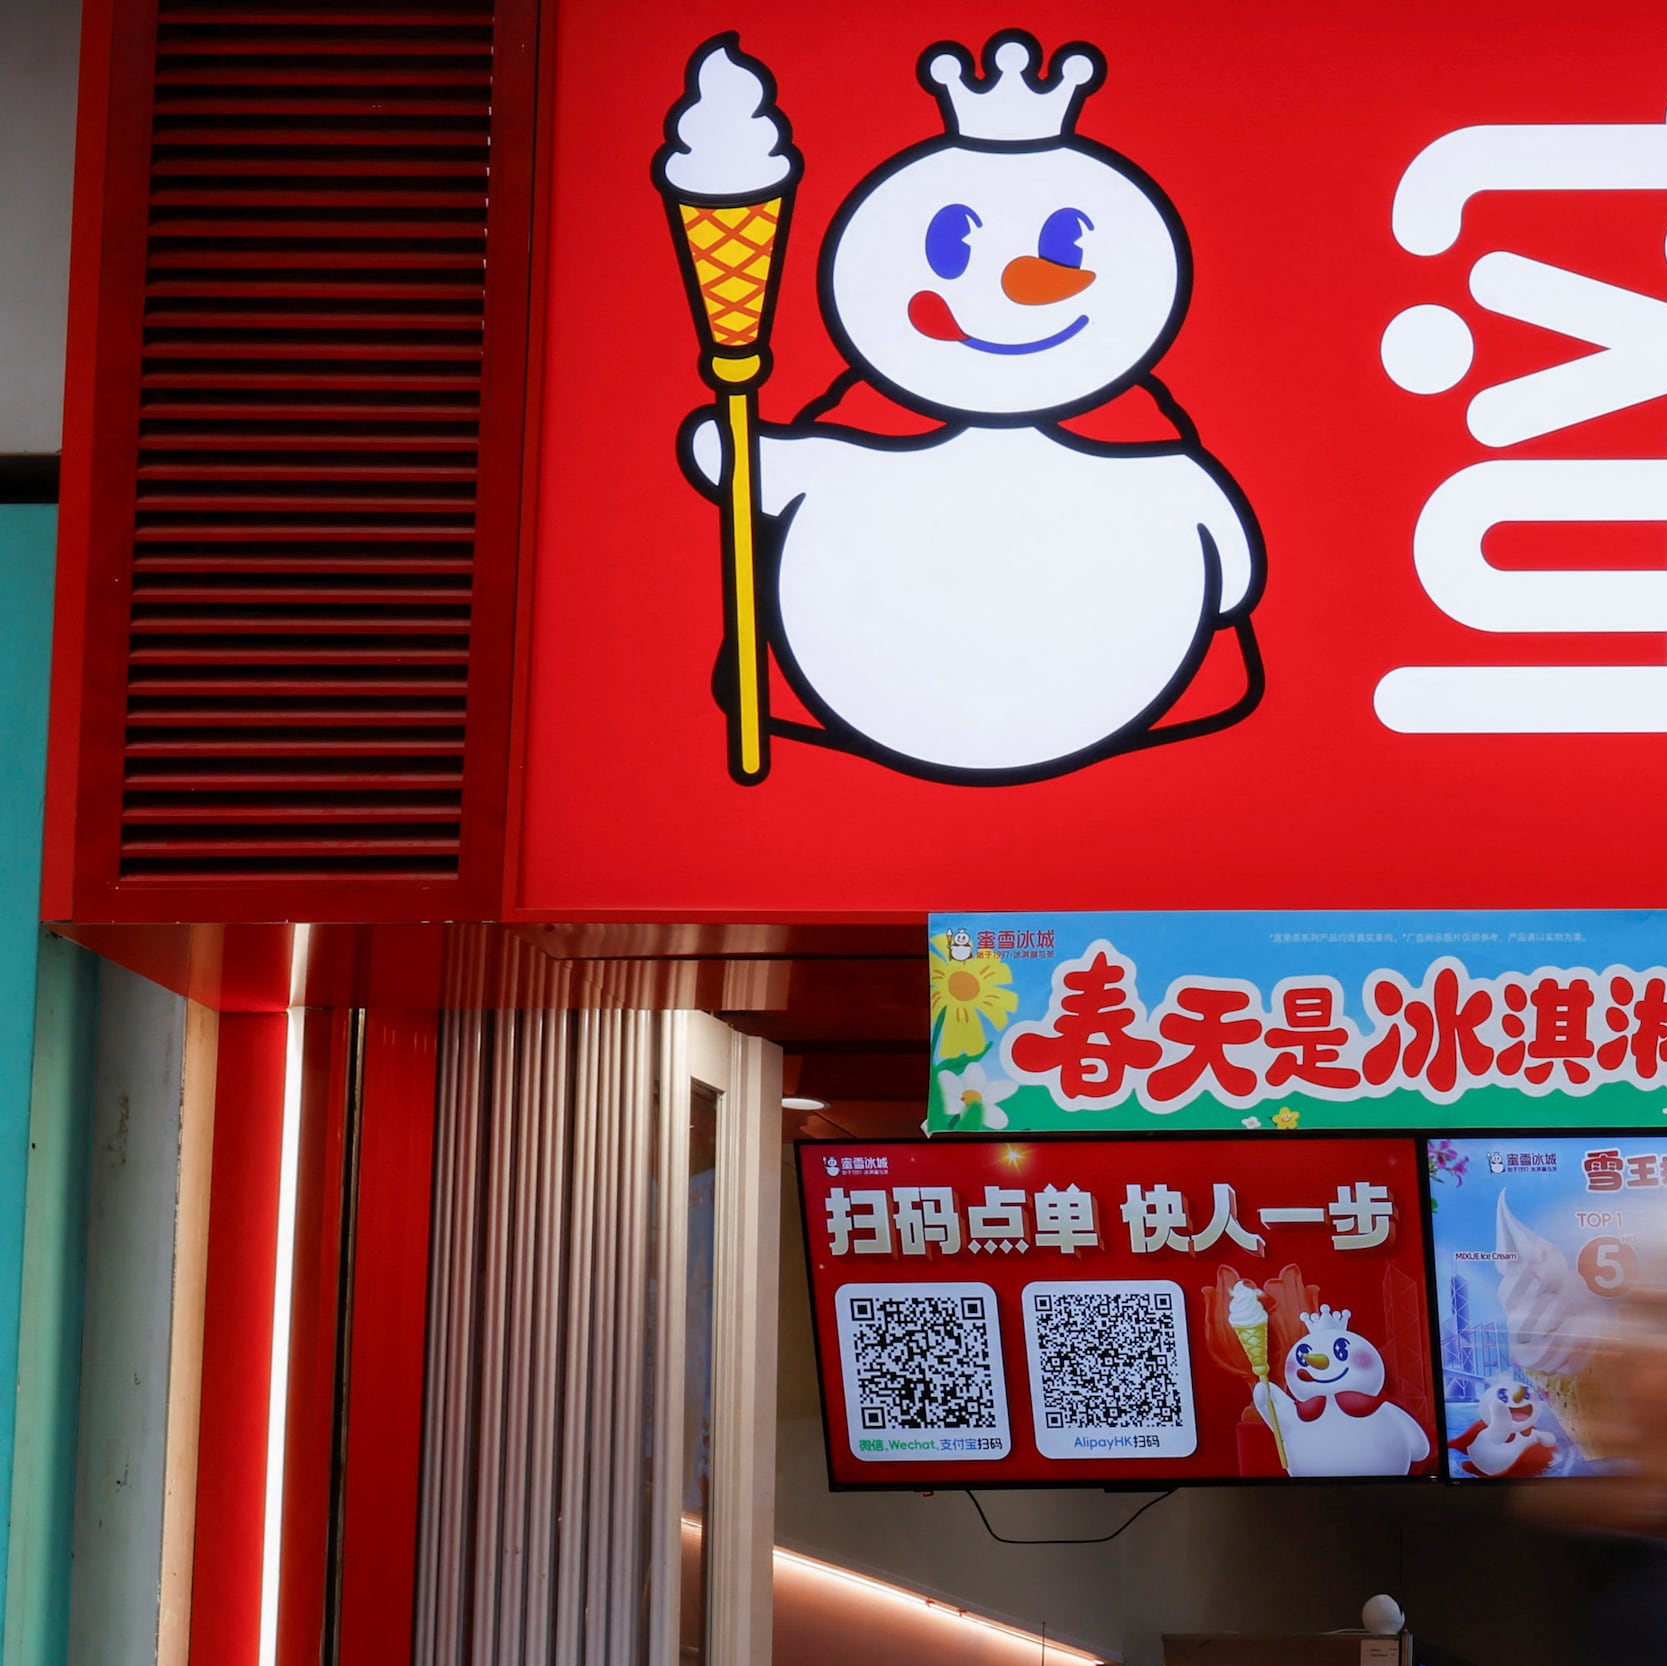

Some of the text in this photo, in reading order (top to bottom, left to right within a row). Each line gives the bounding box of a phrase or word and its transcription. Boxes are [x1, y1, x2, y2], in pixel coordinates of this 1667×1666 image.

[977, 930, 1055, 949] 蜜雪冰城
[1506, 1153, 1557, 1165] 蜜雪冰城
[825, 1181, 1394, 1256] 扫码点单 快人一步
[1576, 1213, 1623, 1228] TOP 1
[1594, 1244, 1625, 1289] 5
[1074, 1435, 1160, 1450] AlipayHK扫码
